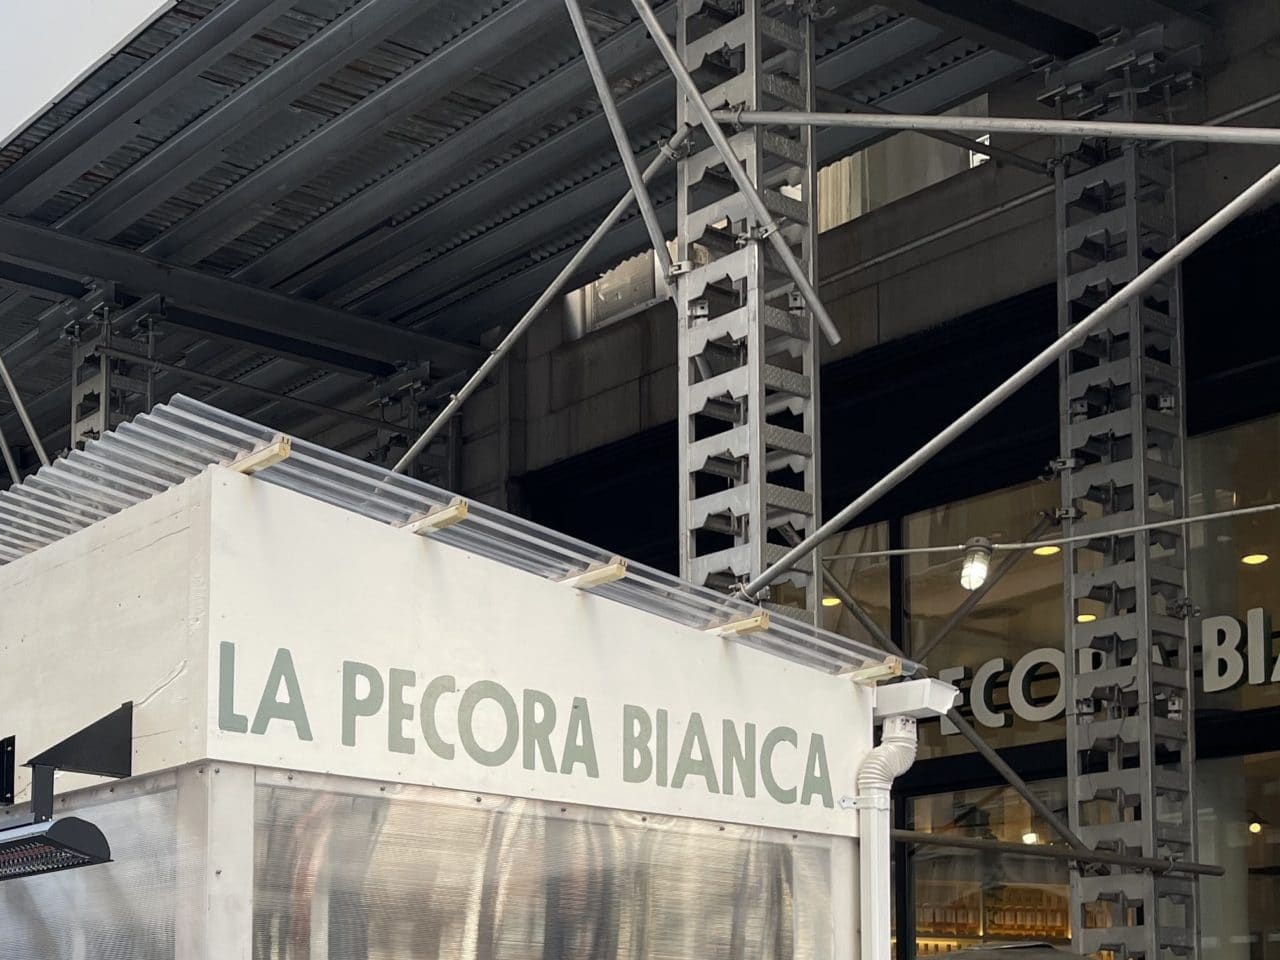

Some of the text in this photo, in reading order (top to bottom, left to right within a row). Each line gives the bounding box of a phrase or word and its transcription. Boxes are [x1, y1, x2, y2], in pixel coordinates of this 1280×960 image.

[219, 640, 836, 809] LA PECORA BIANCA
